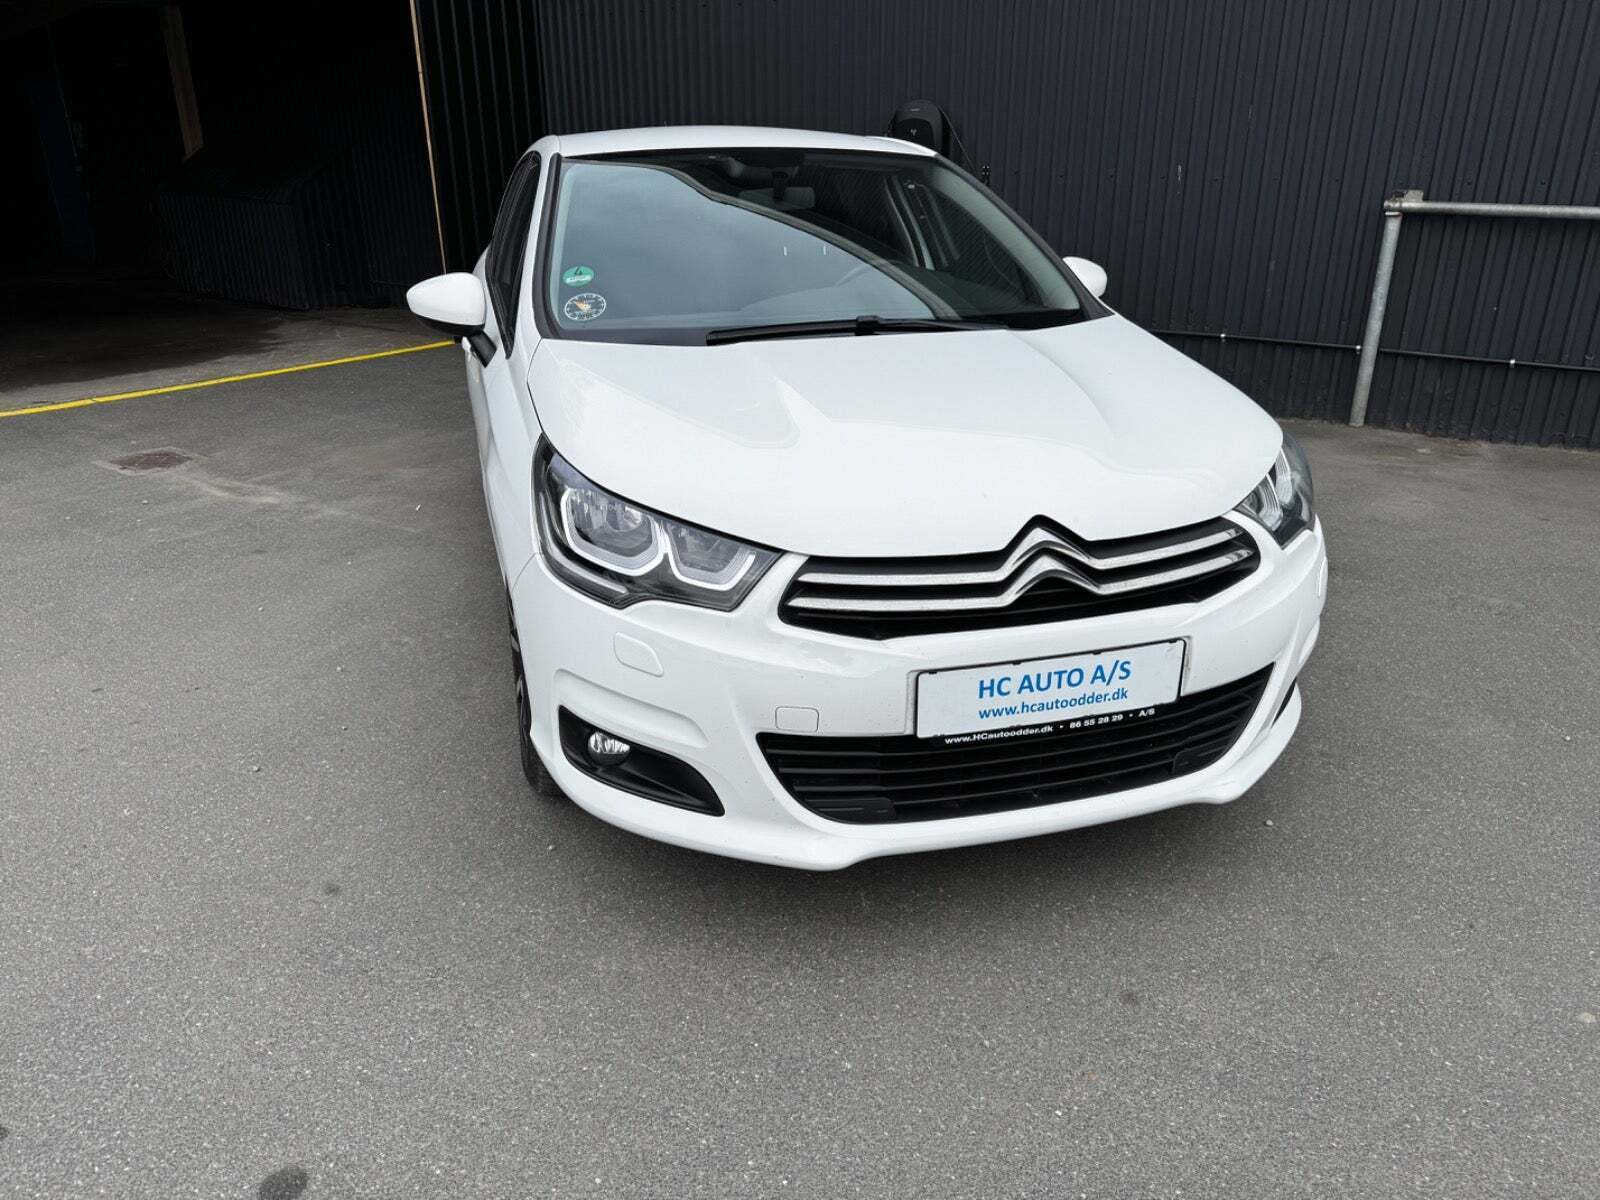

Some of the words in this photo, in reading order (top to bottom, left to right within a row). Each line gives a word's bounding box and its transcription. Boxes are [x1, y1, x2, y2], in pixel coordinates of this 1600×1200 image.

[978, 677, 1011, 699] HC
[1017, 667, 1084, 695] AUTO
[1090, 659, 1132, 686] A/S
[978, 687, 1128, 720] www.hcautoodder.dk
[944, 724, 1053, 744] www.HCautoodder.dk
[1069, 721, 1082, 729] 86
[1083, 718, 1095, 727] 55
